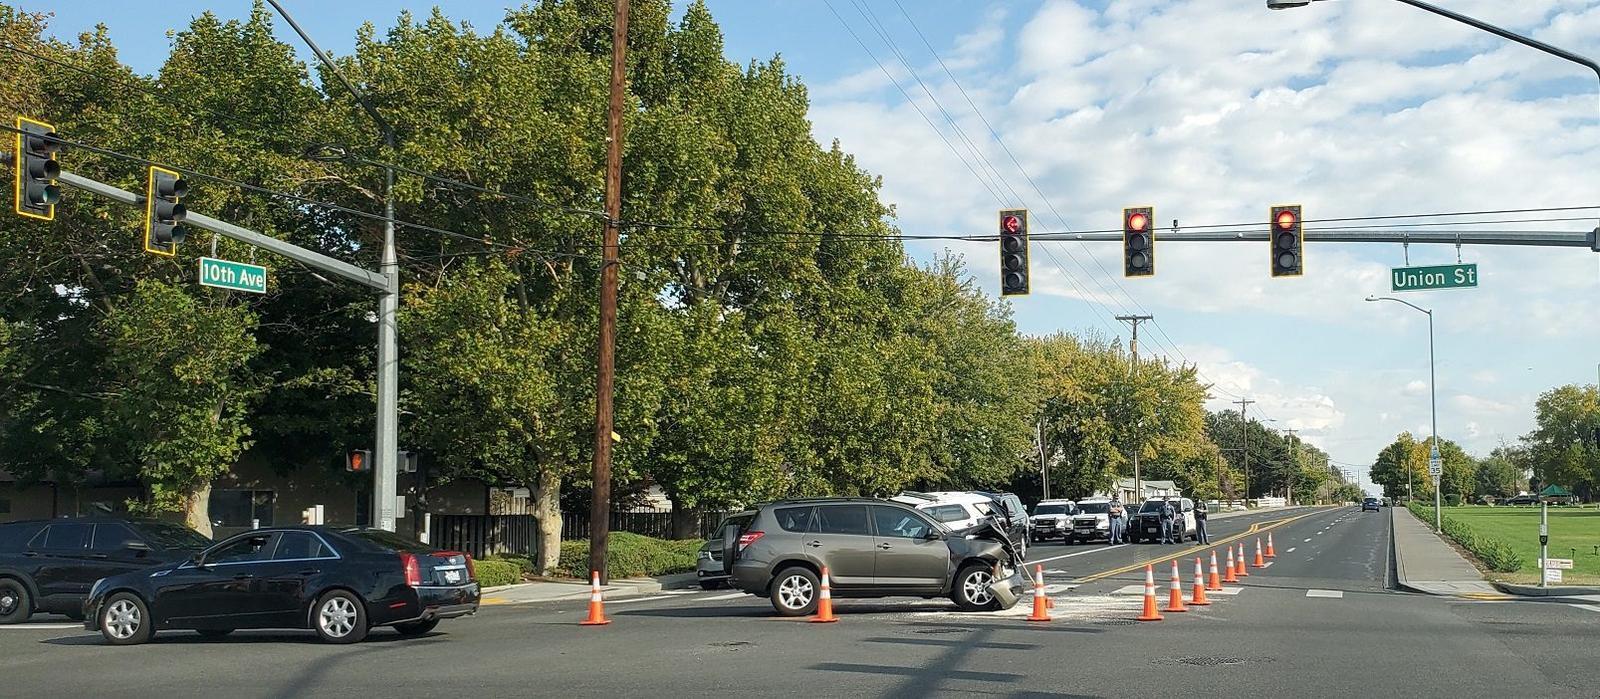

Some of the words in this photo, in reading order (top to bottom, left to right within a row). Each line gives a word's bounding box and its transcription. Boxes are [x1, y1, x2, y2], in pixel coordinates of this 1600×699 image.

[204, 263, 235, 283] 10th
[239, 269, 263, 287] Ave
[1394, 271, 1445, 287] Union
[1454, 268, 1475, 284] St
